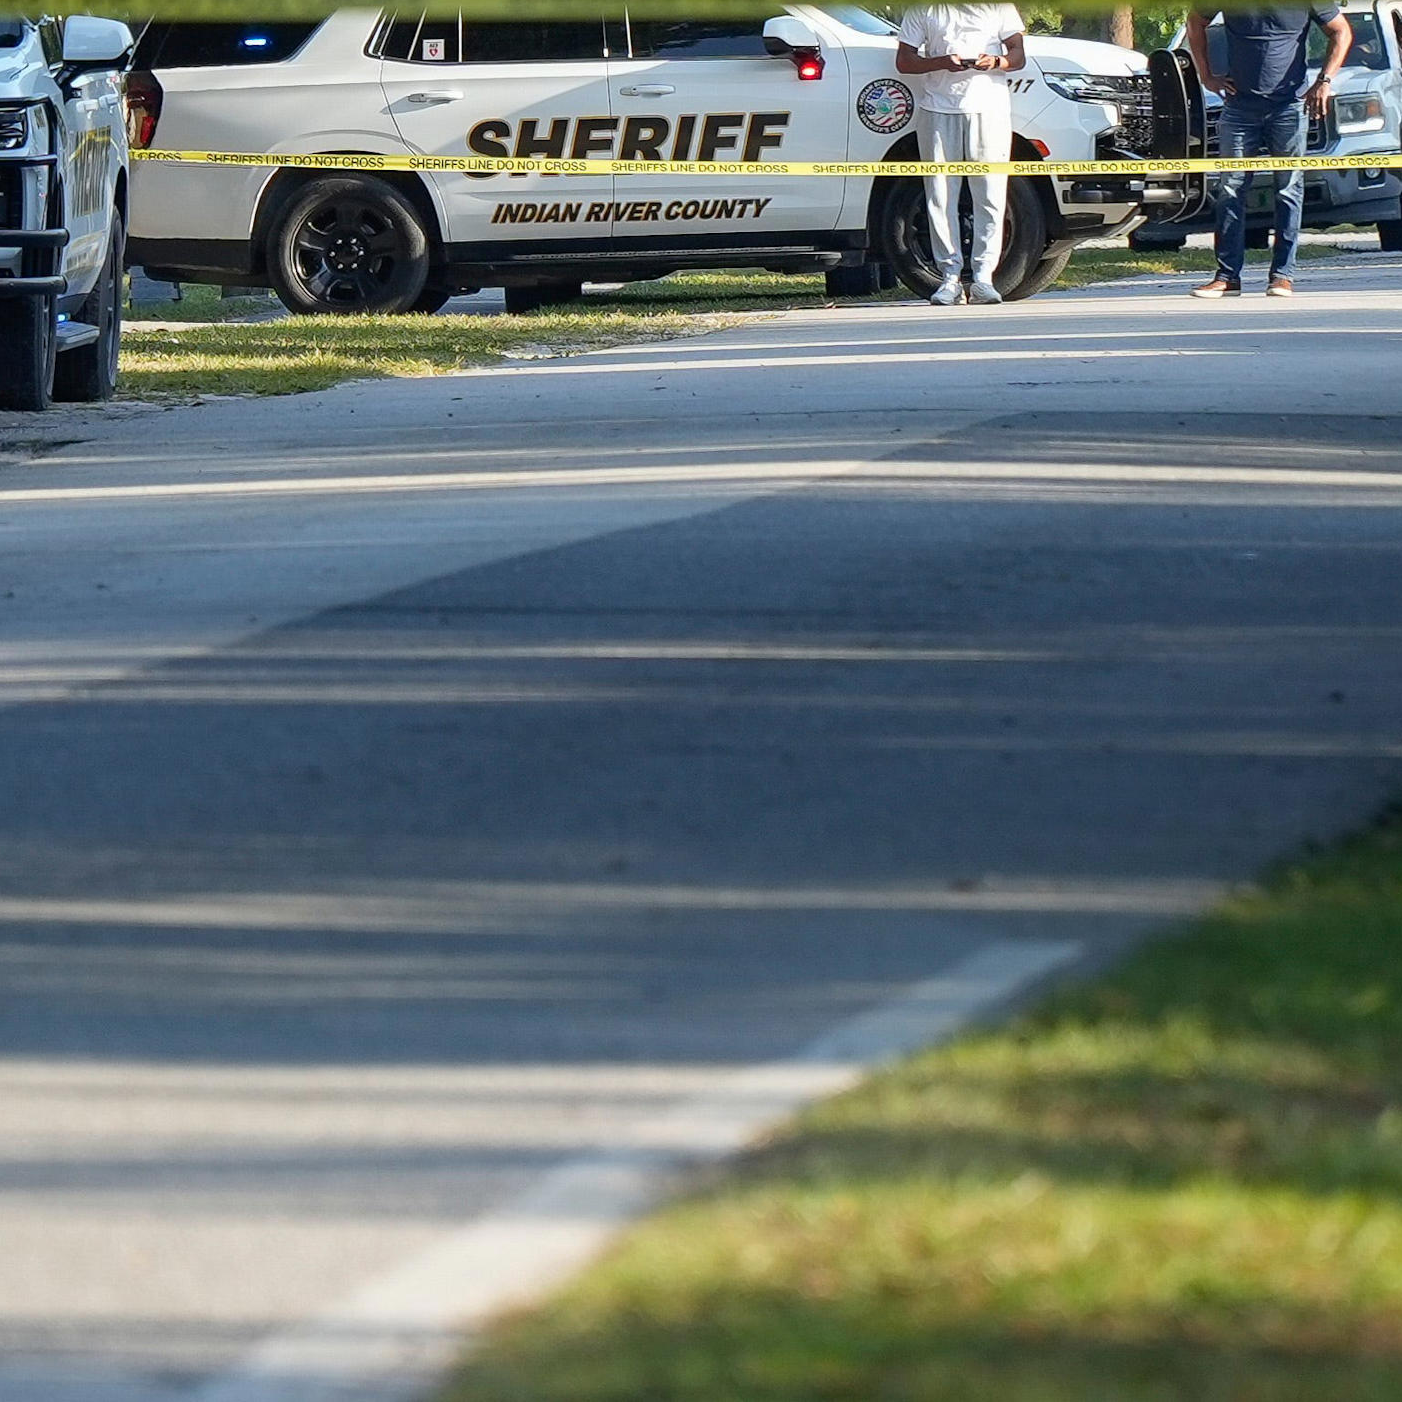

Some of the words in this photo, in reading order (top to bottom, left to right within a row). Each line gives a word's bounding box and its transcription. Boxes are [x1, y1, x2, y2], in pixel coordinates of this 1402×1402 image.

[462, 110, 792, 180] SHERIFF
[314, 156, 340, 167] NOT
[342, 156, 385, 168] CROSS
[408, 158, 465, 170] SHERIFFS
[468, 159, 493, 170] LINE
[497, 159, 514, 171] DO
[517, 160, 542, 171] NOT
[544, 160, 587, 172] CROSS
[611, 163, 667, 172] SHERIFFS
[670, 163, 696, 173] LINE
[698, 163, 717, 173] DO
[719, 164, 743, 173] NOT
[746, 164, 789, 173] CROSS
[1013, 163, 1070, 173] SHERIFFS
[1073, 163, 1098, 172] LINE
[1100, 162, 1118, 172] DO
[1121, 162, 1145, 171] NOT
[1148, 161, 1190, 171] CROSS
[1214, 160, 1270, 170] SHERIFFS
[1273, 159, 1298, 168] LINE
[1300, 159, 1318, 167] DO
[1321, 158, 1345, 167] NOT
[812, 164, 868, 174] SHERIFFS
[871, 164, 897, 174] LINE
[900, 164, 918, 174] DO
[920, 164, 945, 174] NOT
[948, 164, 990, 174] CROSS
[490, 202, 582, 224] INDIAN
[584, 201, 660, 223] RIVER
[662, 197, 773, 221] COUNTY
